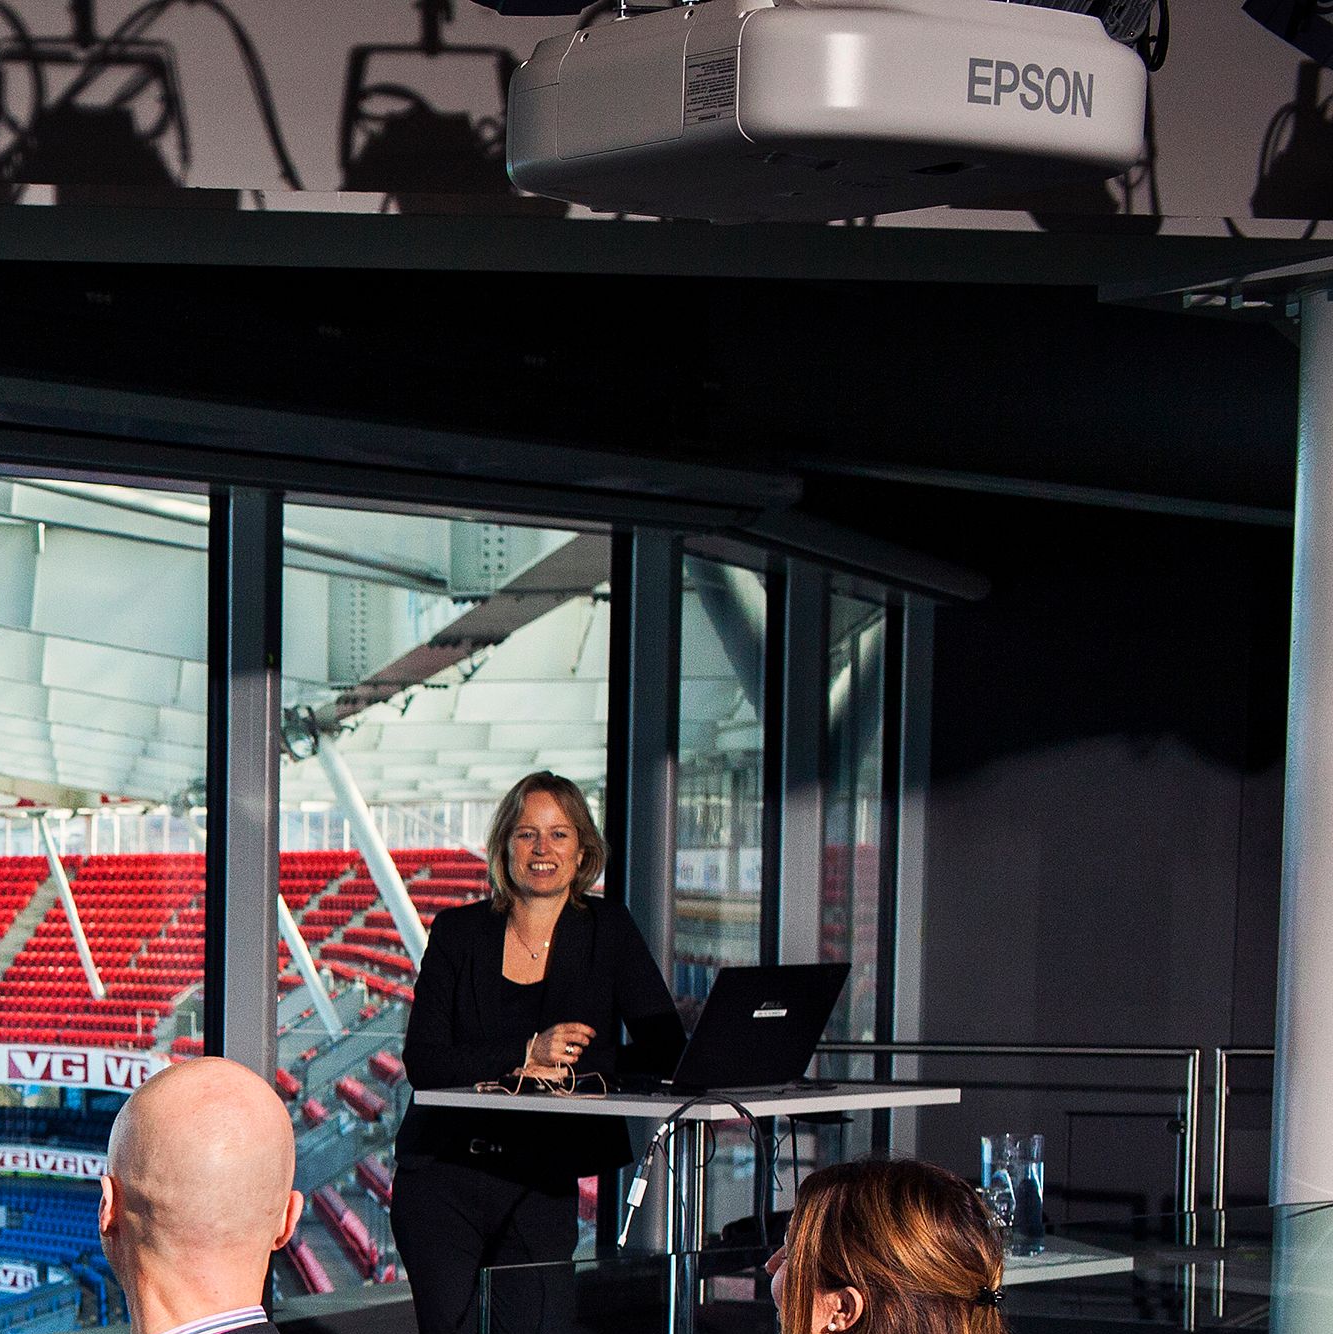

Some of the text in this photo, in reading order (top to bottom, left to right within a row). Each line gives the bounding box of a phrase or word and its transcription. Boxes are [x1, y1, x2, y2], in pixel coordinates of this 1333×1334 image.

[967, 57, 1094, 118] EPSON
[8, 1050, 89, 1083] VG
[35, 1154, 78, 1176] VG
